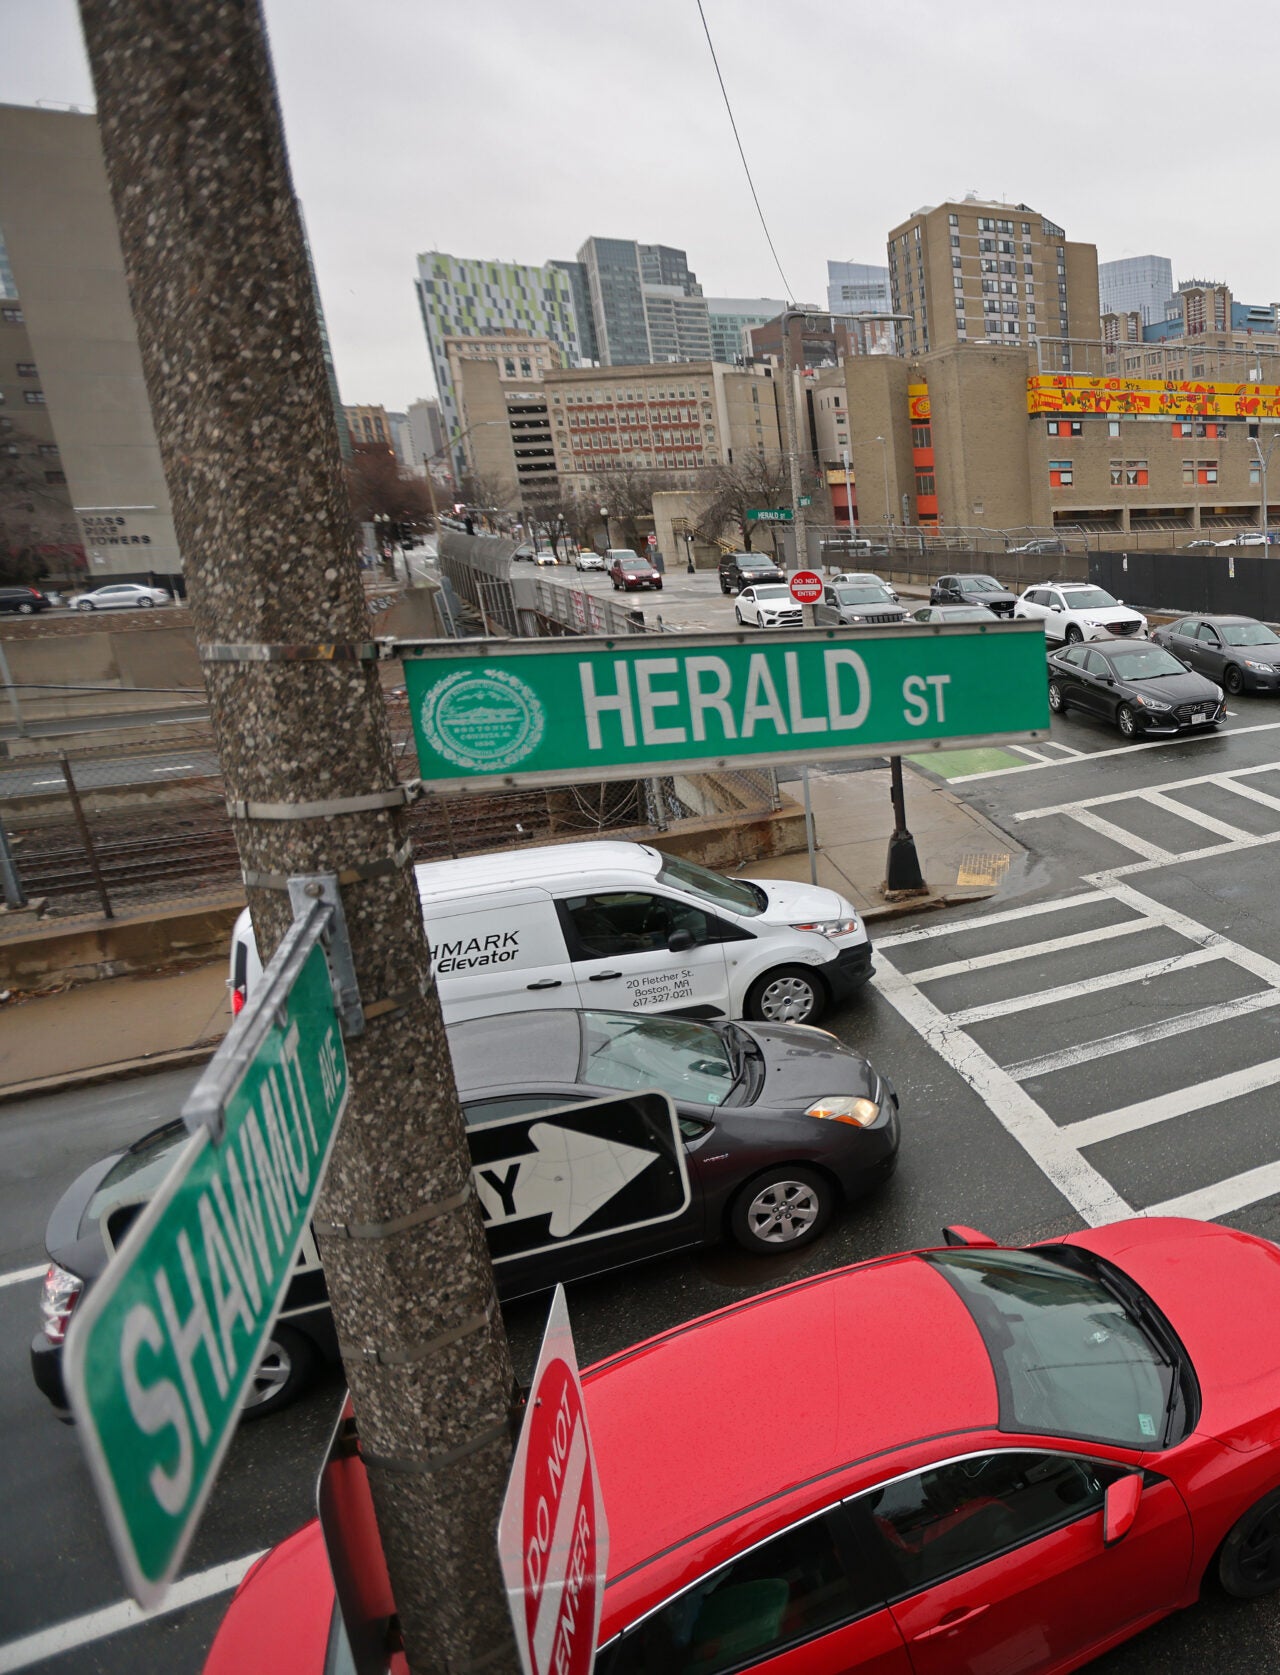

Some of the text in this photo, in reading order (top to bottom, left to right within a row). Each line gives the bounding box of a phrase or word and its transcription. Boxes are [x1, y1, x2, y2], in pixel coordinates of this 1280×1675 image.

[81, 516, 126, 526] MASS
[85, 526, 118, 536] PIKE
[88, 535, 151, 545] TOWERS
[578, 648, 951, 750] HERALD ST
[437, 949, 519, 973] Elevator
[626, 969, 694, 989] 20 Fletcher St.
[674, 979, 690, 988] MA
[632, 988, 693, 1008] 617-327-0211
[120, 1022, 343, 1516] SHAWMUT AVE
[526, 1379, 573, 1600] DO NOT
[555, 1504, 590, 1675] ENTER
